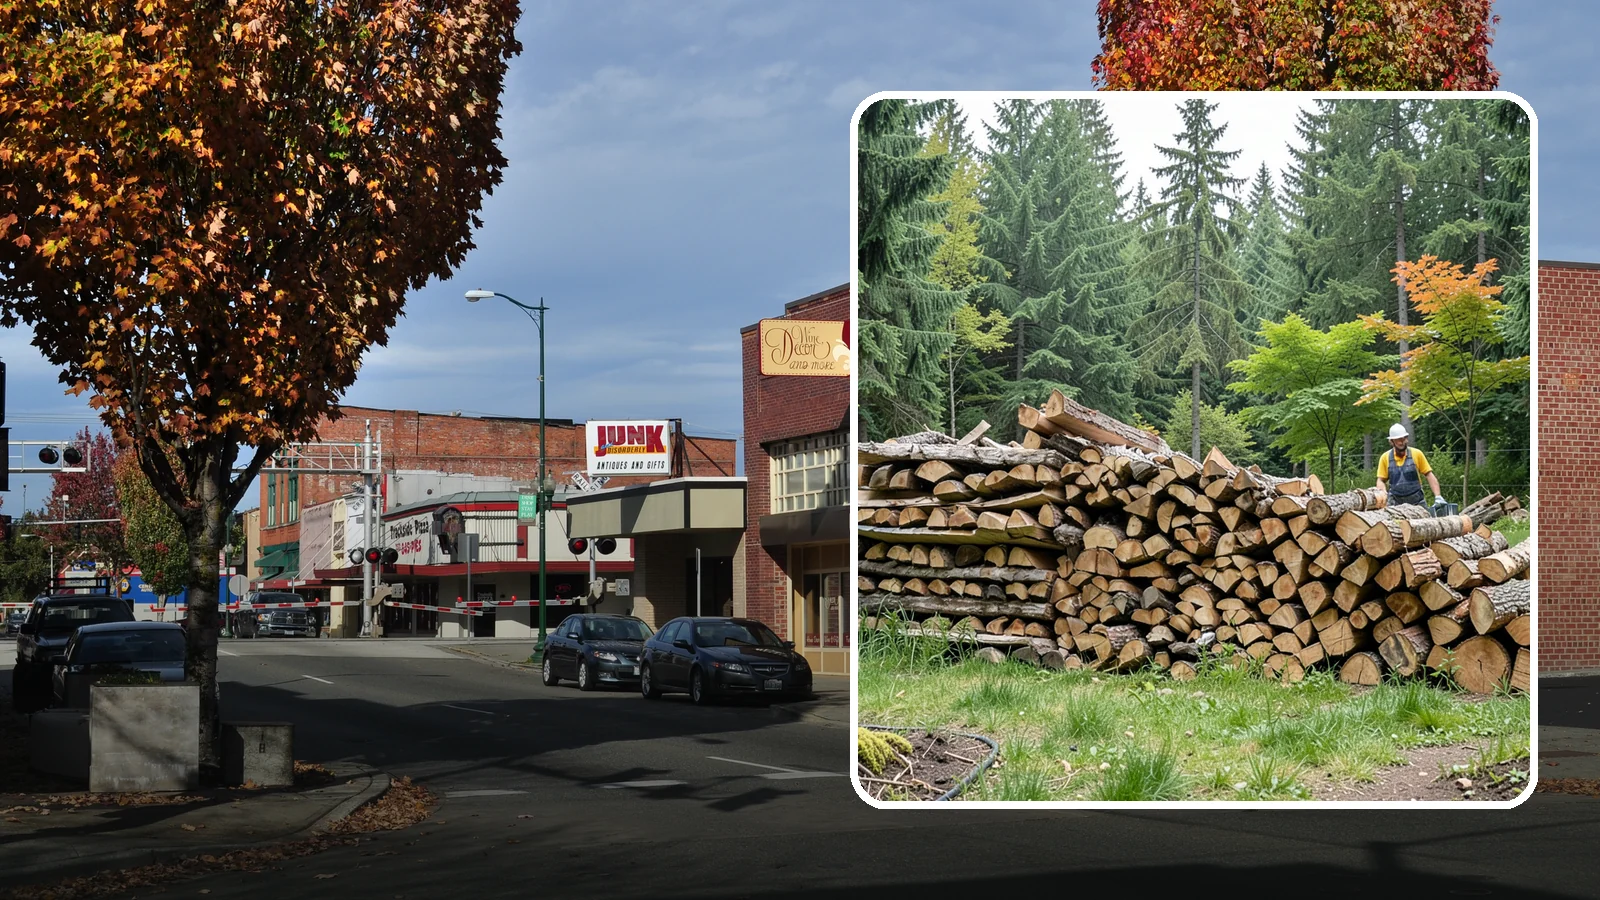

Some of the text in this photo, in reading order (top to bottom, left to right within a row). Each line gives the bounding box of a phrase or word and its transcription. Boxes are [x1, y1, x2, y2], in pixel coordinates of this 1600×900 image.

[765, 328, 831, 365] Decor
[596, 426, 665, 457] JUNK
[607, 446, 646, 454] DISORDERLY
[597, 460, 665, 469] ANTIQUES AND GIFTS
[390, 519, 429, 539] Trackside Pizza
